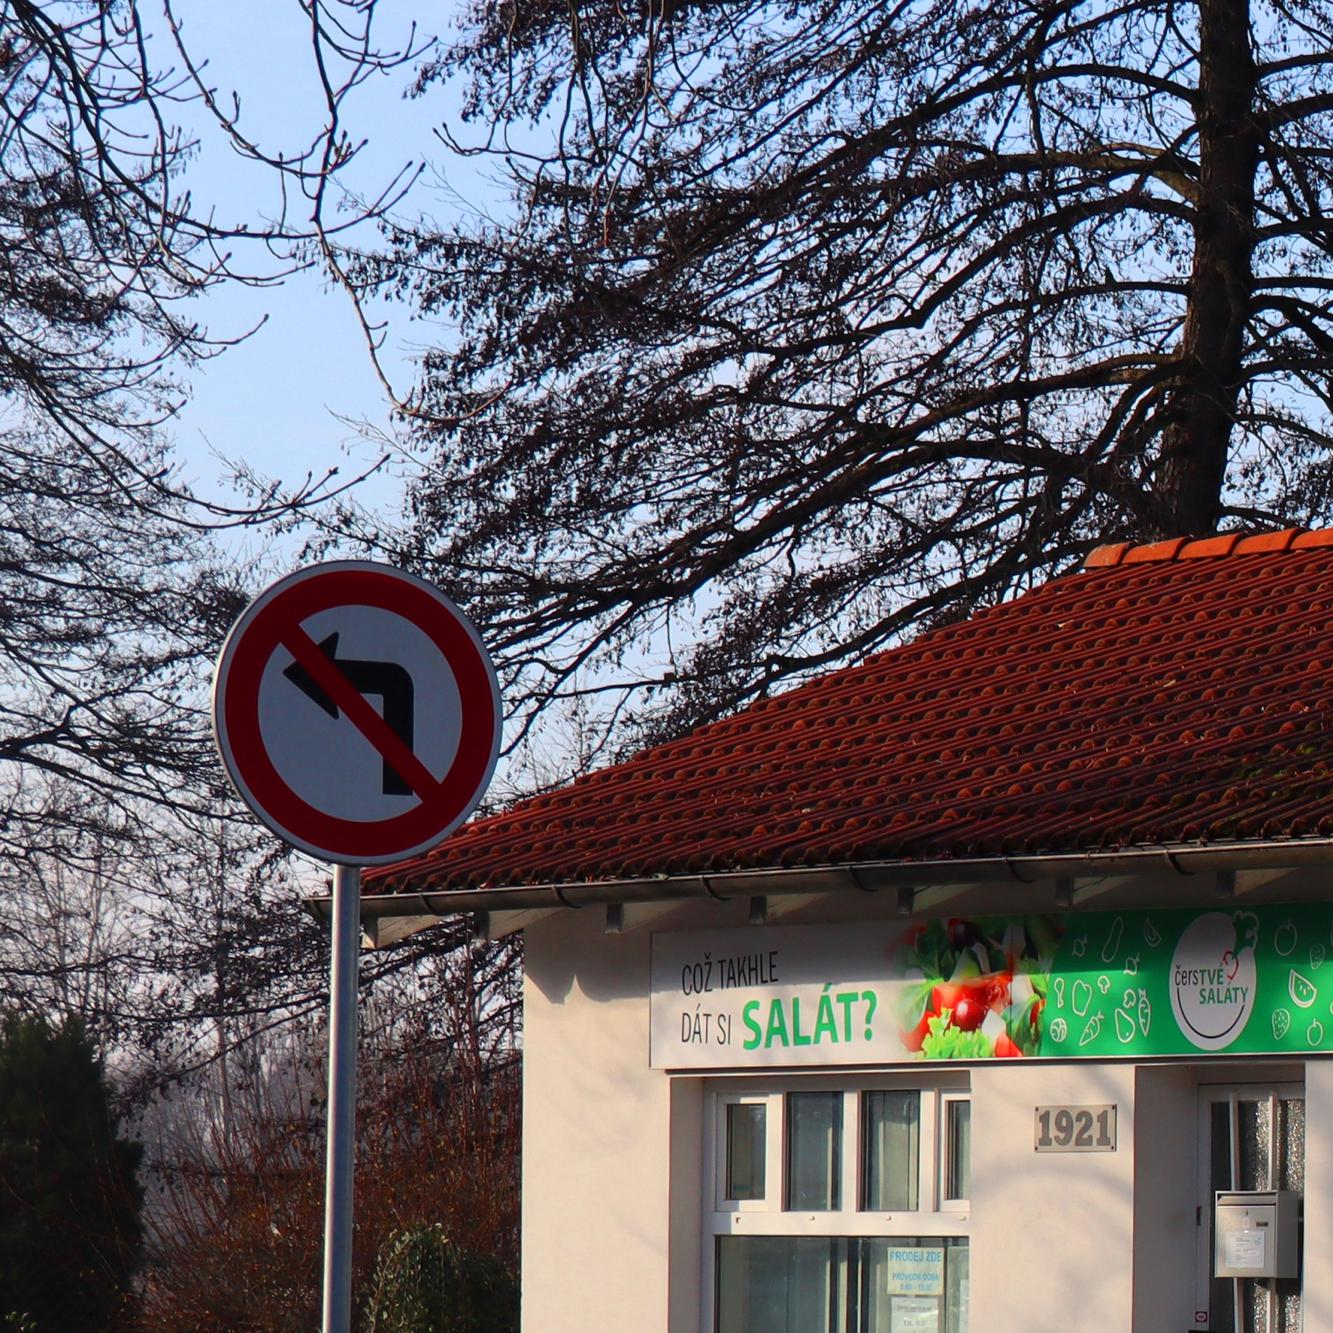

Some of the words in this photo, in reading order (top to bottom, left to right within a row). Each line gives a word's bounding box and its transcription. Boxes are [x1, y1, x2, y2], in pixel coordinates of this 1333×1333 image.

[682, 952, 713, 996] COŽ
[717, 951, 778, 989] TAKHLE
[1199, 981, 1249, 1004] SALÁTY
[681, 1003, 713, 1045] DÁT
[716, 1014, 731, 1045] SI
[742, 982, 877, 1050] SALÁT?
[1038, 1109, 1111, 1146] 1921
[889, 1251, 924, 1262] PRODEJ
[926, 1251, 942, 1262] ZDE
